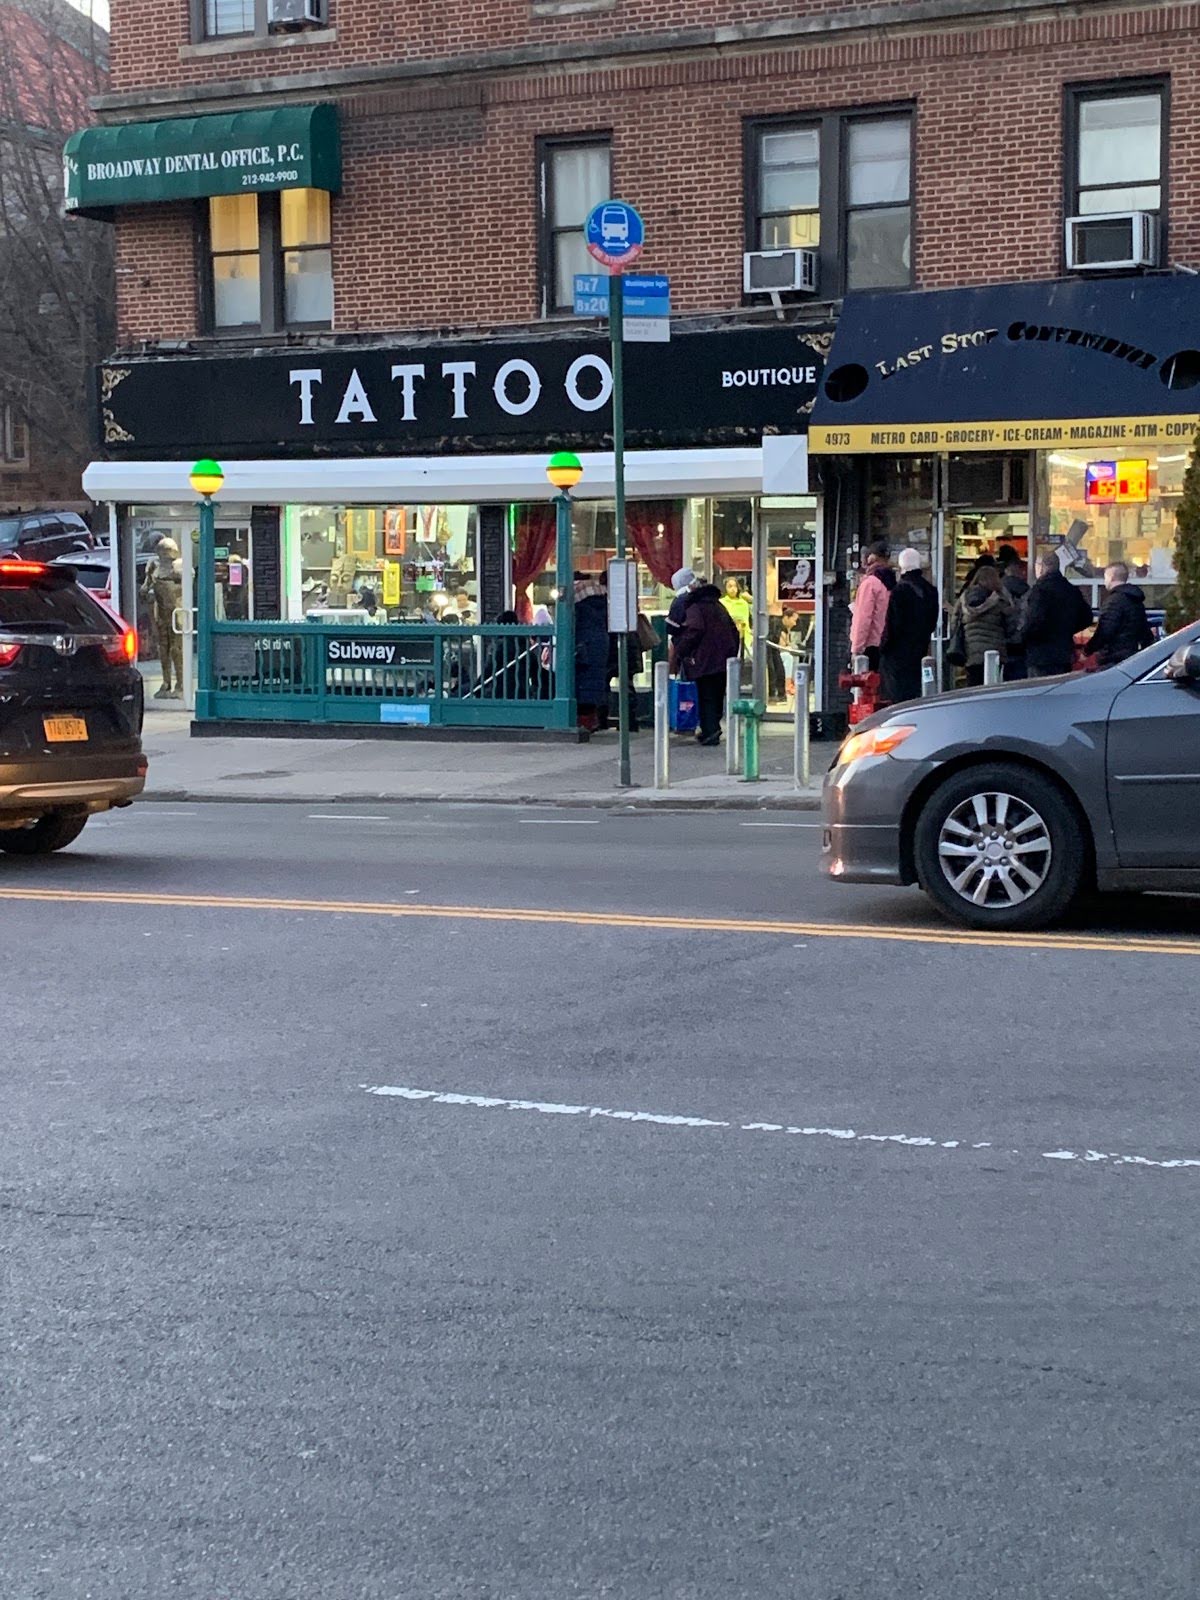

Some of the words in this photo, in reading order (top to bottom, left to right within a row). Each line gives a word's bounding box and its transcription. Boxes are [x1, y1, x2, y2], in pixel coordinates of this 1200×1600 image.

[87, 158, 161, 180] BROADWAY
[165, 152, 219, 173] DENTAL
[221, 146, 275, 168] OFFICE,
[278, 143, 304, 162] P.C.
[242, 170, 298, 186] 212-942-9900
[576, 278, 599, 292] Bx7
[722, 366, 816, 387] BOUTIQUE
[289, 354, 613, 424] TATTOO
[825, 433, 850, 445] 4973
[871, 432, 905, 445] METRO
[910, 431, 938, 444] CARD
[946, 429, 994, 443] GROCERY
[1003, 428, 1062, 441] ICE-CREAM
[1070, 425, 1126, 439] MAGAZINE
[1134, 424, 1157, 437] ATM
[328, 640, 395, 663] Subway
